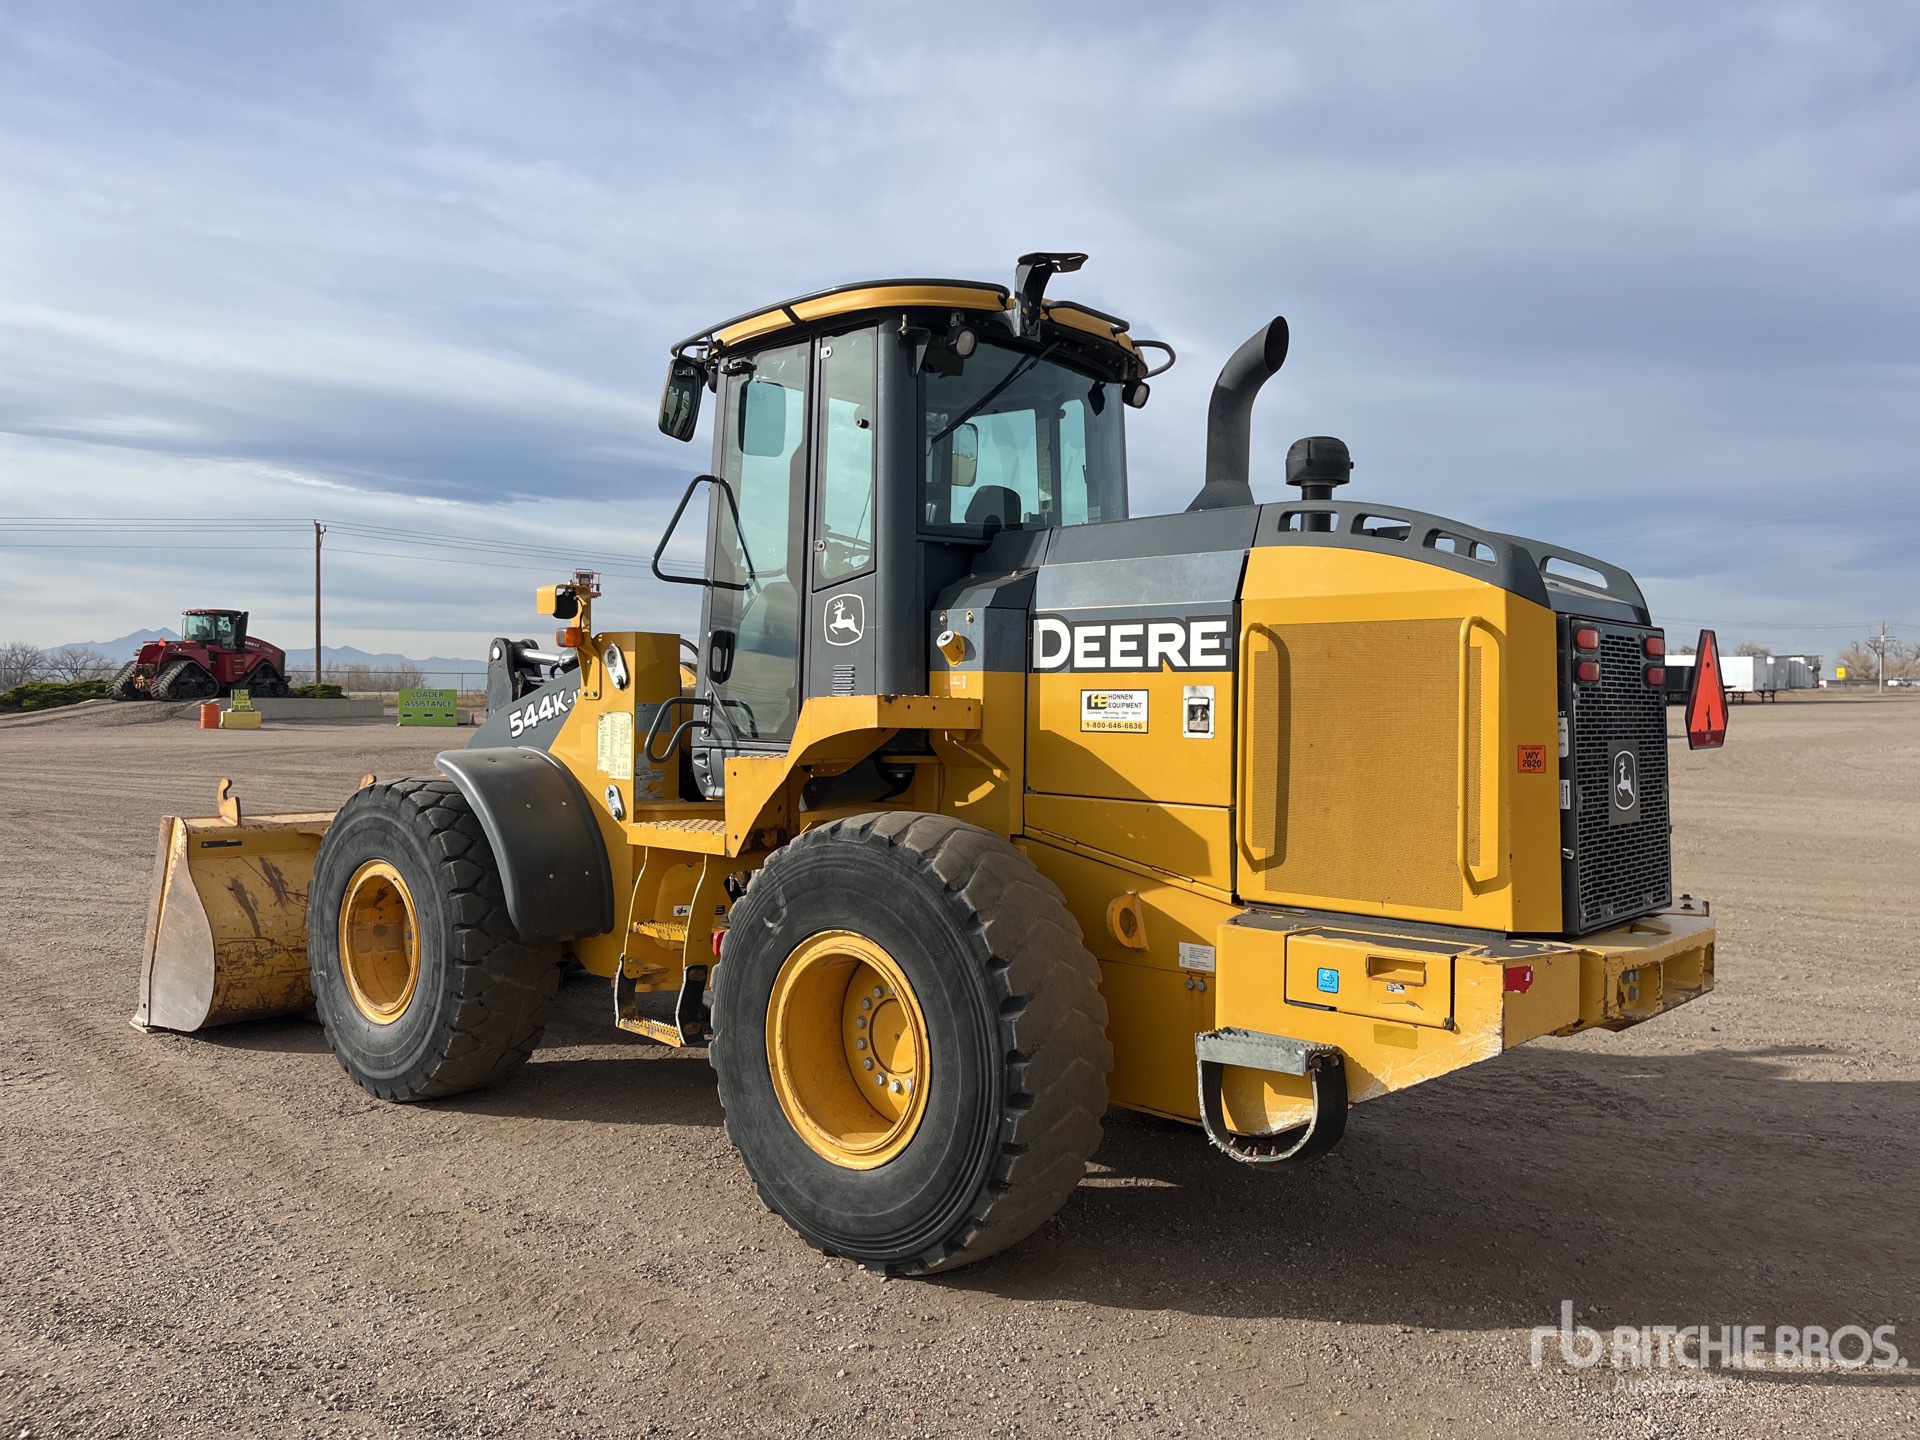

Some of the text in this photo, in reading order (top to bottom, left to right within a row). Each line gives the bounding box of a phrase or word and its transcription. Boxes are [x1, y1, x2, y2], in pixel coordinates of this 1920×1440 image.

[1033, 618, 1227, 668] DEERE
[508, 687, 581, 738] 544K-I
[1522, 760, 1542, 768] 2020
[1525, 751, 1540, 759] WY
